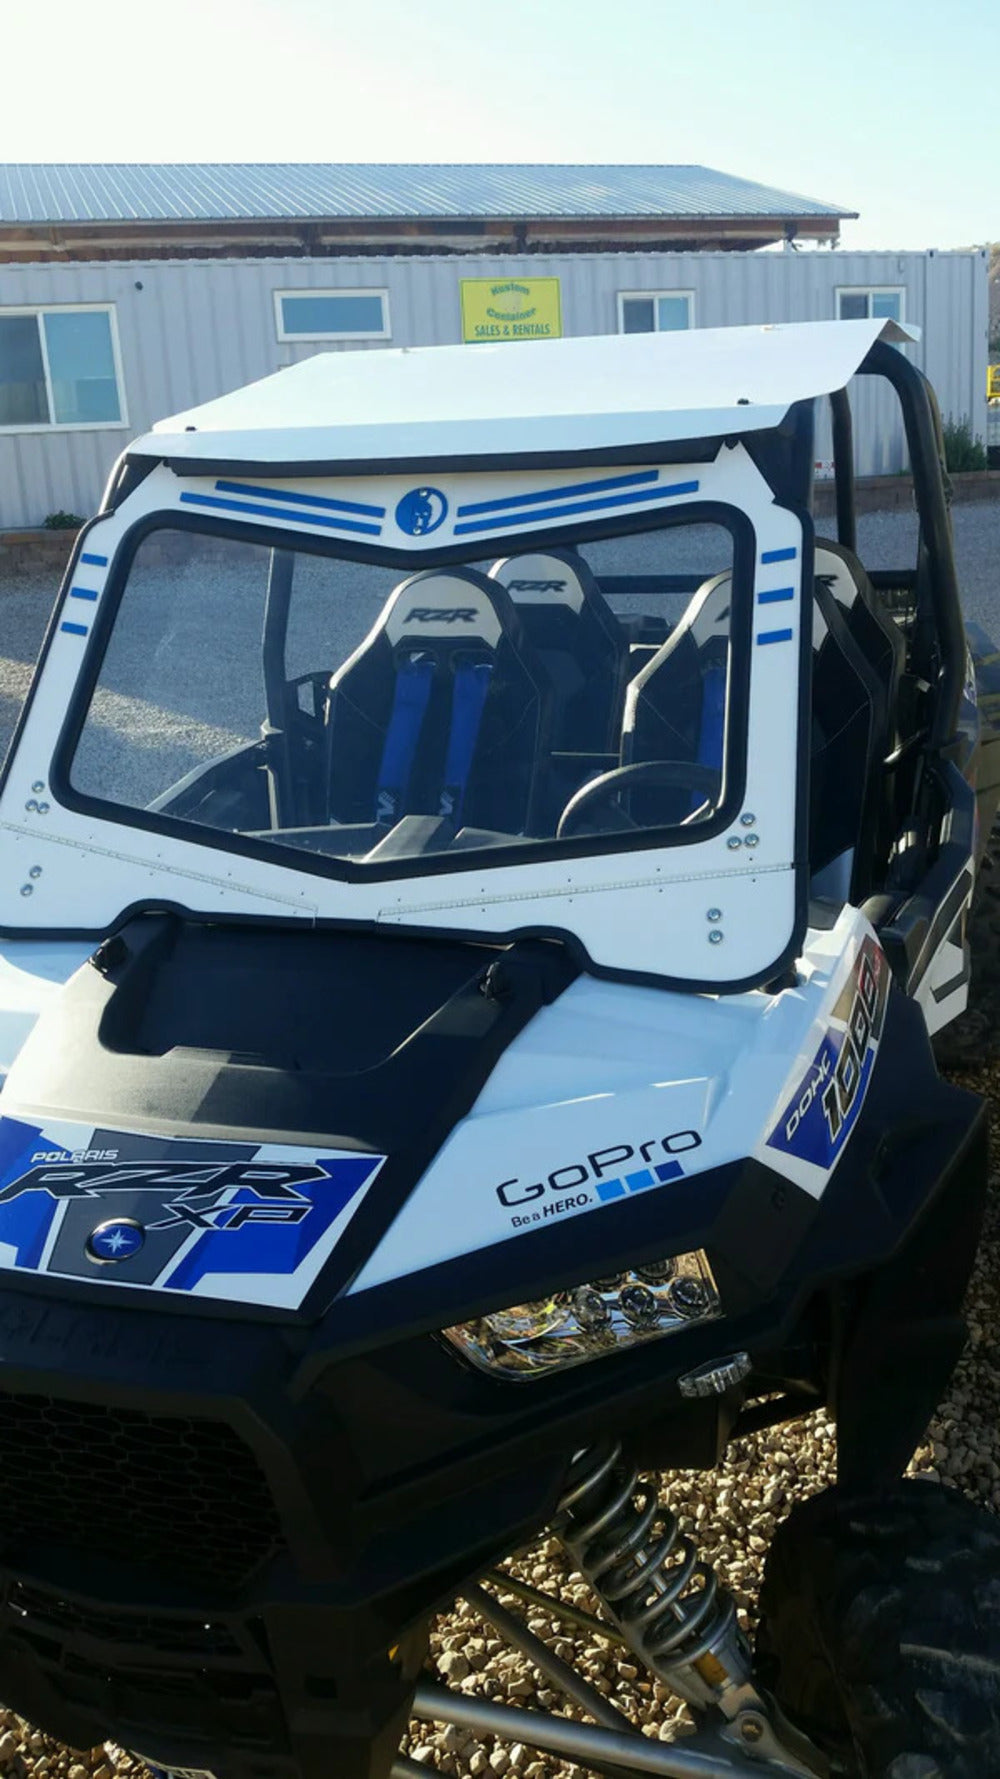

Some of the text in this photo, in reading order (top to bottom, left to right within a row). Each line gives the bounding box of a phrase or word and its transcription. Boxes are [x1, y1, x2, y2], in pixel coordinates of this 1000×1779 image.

[486, 307, 536, 321] Container
[475, 323, 550, 336] SALES & RENTALS
[506, 578, 567, 594] RZR
[403, 606, 479, 624] RZR
[786, 1050, 832, 1141] DOHC
[30, 1149, 120, 1163] POLARIS
[496, 1130, 702, 1207] GoPro
[0, 1160, 333, 1203] RZR
[144, 1203, 313, 1230] XP
[511, 1193, 593, 1228] Be a HERO.
